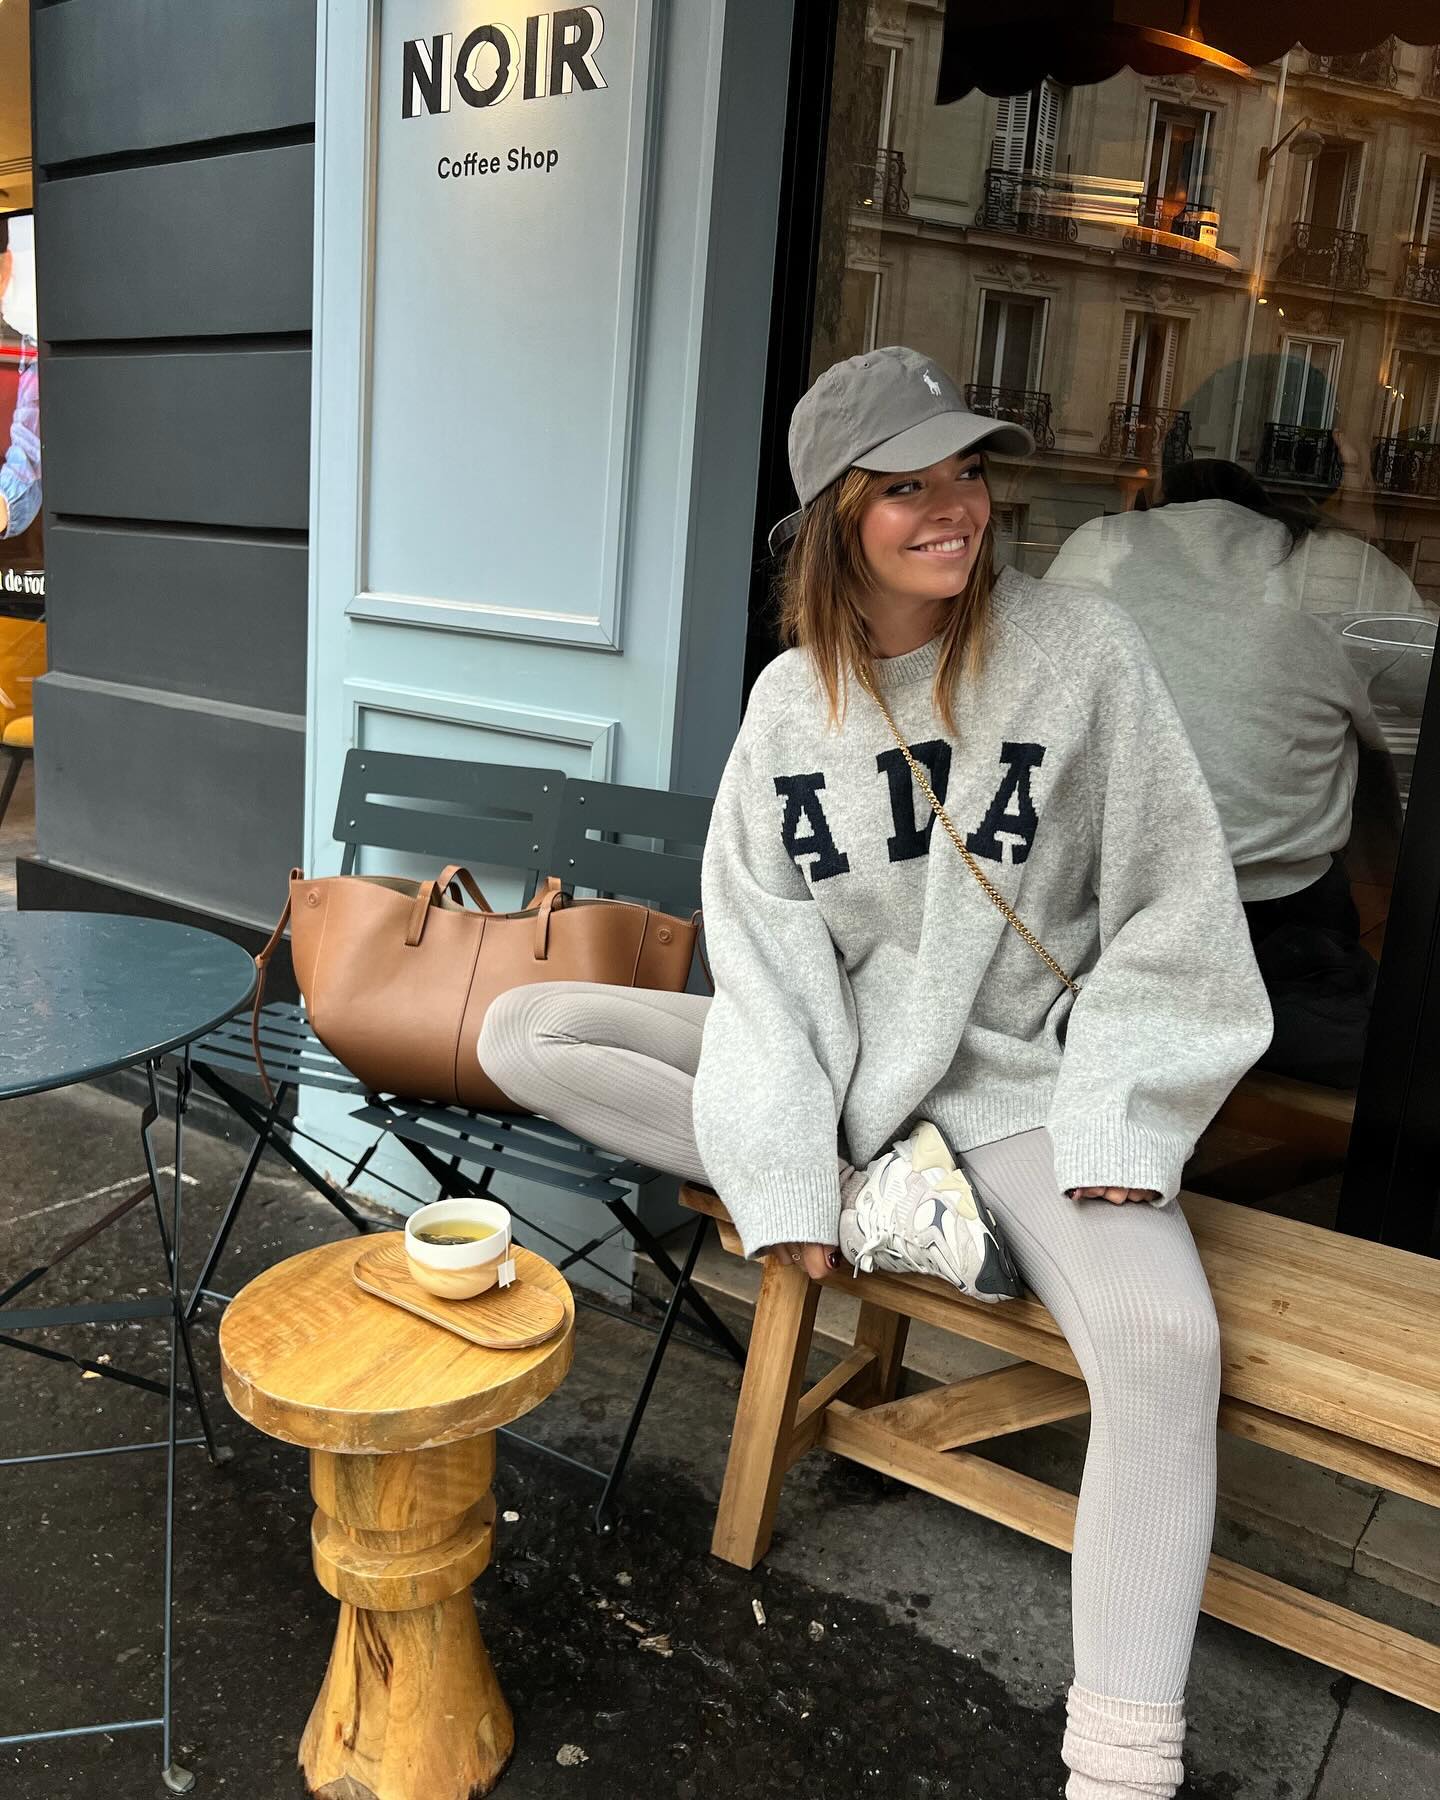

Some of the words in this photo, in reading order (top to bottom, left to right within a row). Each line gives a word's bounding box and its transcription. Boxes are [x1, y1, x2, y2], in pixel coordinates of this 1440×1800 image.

[402, 5, 608, 119] NOIR
[438, 152, 500, 179] Coffee
[507, 146, 559, 173] Shop
[5, 568, 22, 592] de
[773, 739, 1047, 882] ADA
